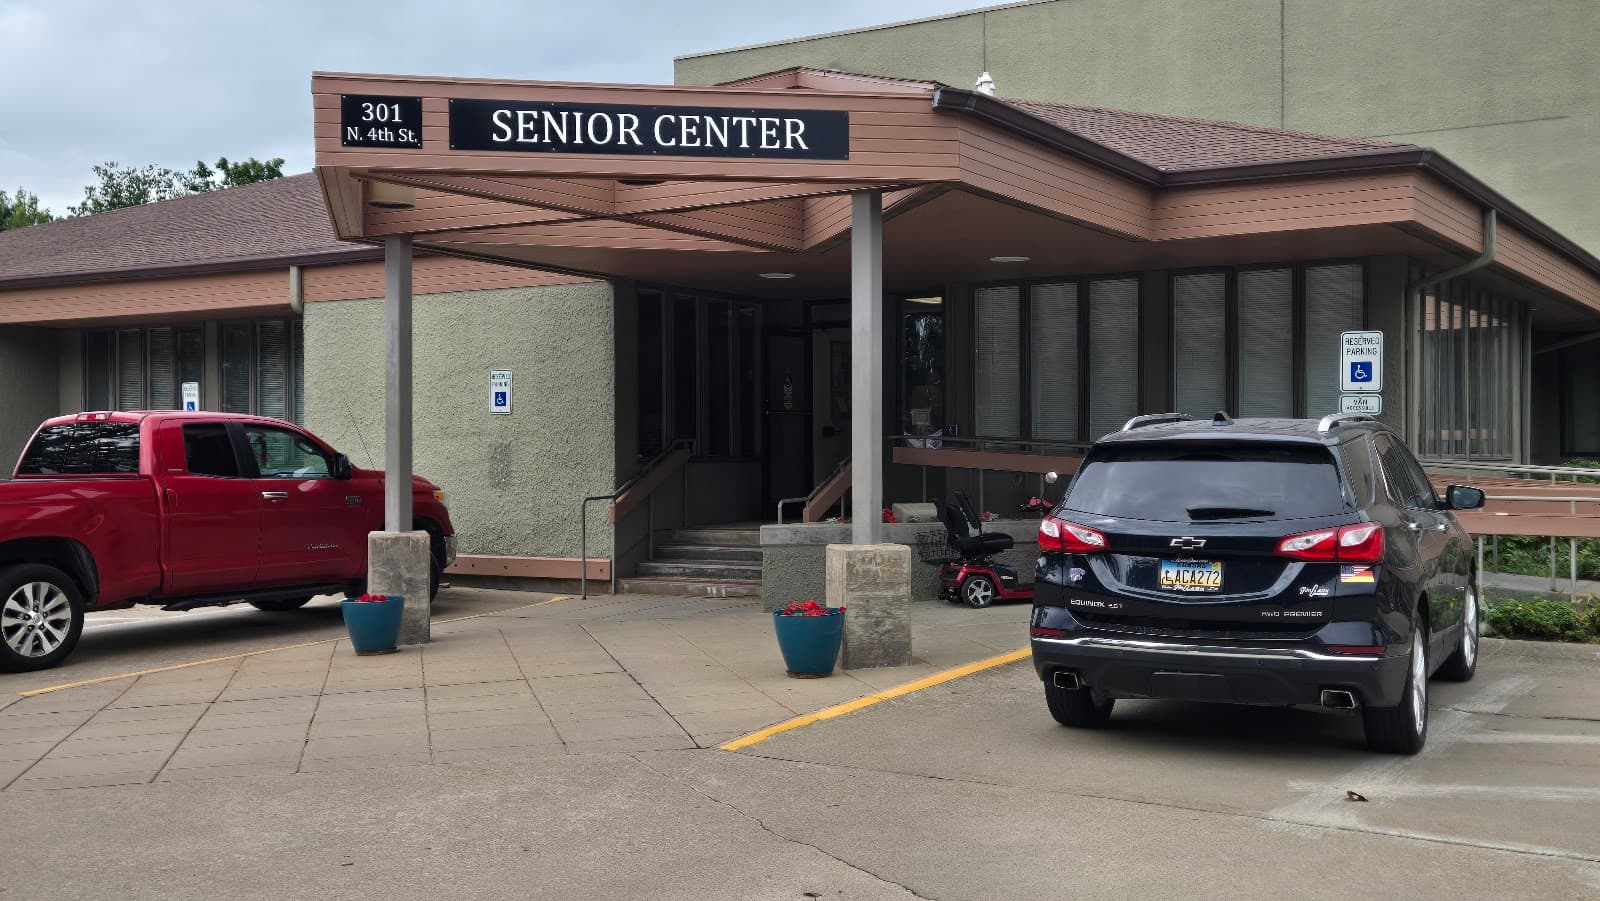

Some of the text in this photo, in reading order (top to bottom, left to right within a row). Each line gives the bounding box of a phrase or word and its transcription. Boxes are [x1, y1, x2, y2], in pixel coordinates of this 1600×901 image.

[361, 102, 403, 122] 301
[346, 126, 418, 143] N. 4th St.
[492, 109, 809, 150] SENIOR CENTER
[1345, 337, 1380, 346] RESERVED
[1346, 347, 1377, 356] PARKING
